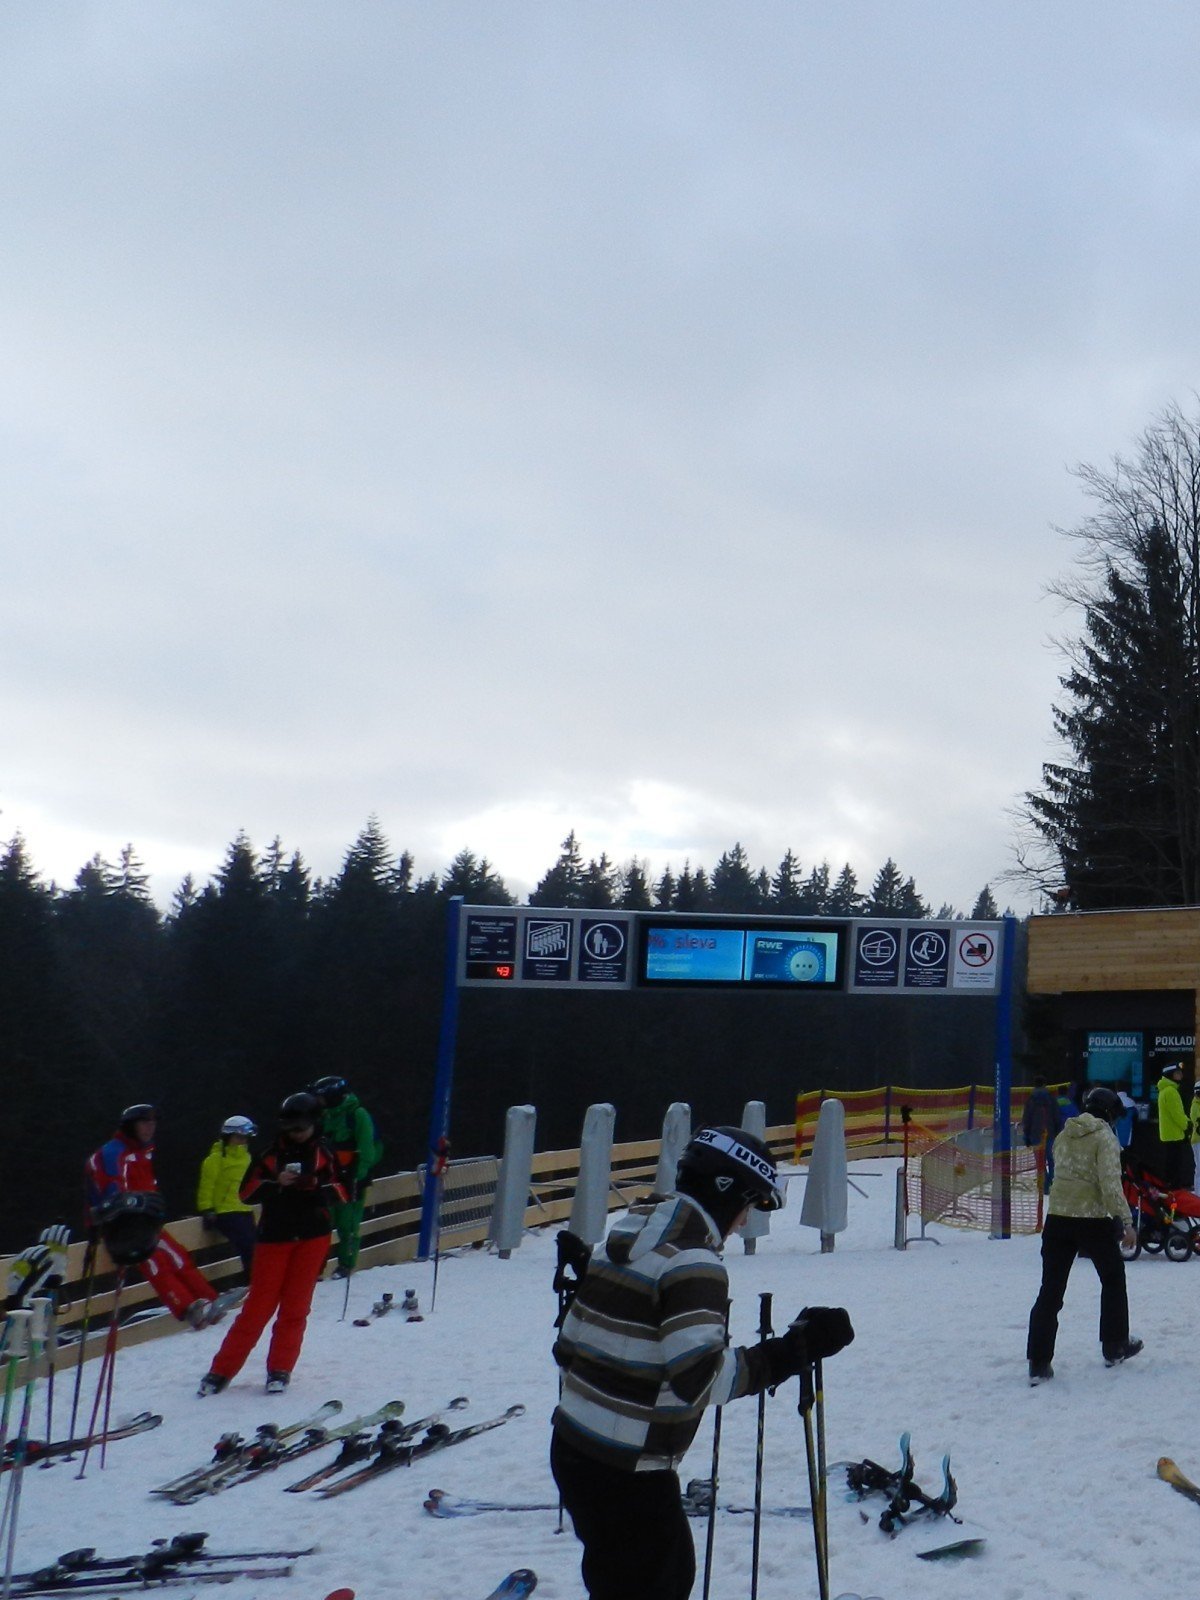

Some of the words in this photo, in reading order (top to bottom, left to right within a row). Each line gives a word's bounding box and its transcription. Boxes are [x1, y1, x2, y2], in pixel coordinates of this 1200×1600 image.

[757, 940, 783, 950] RWE
[1088, 1036, 1138, 1046] POKLADNA
[1155, 1036, 1196, 1046] POKLAD
[735, 1146, 779, 1183] uvex
